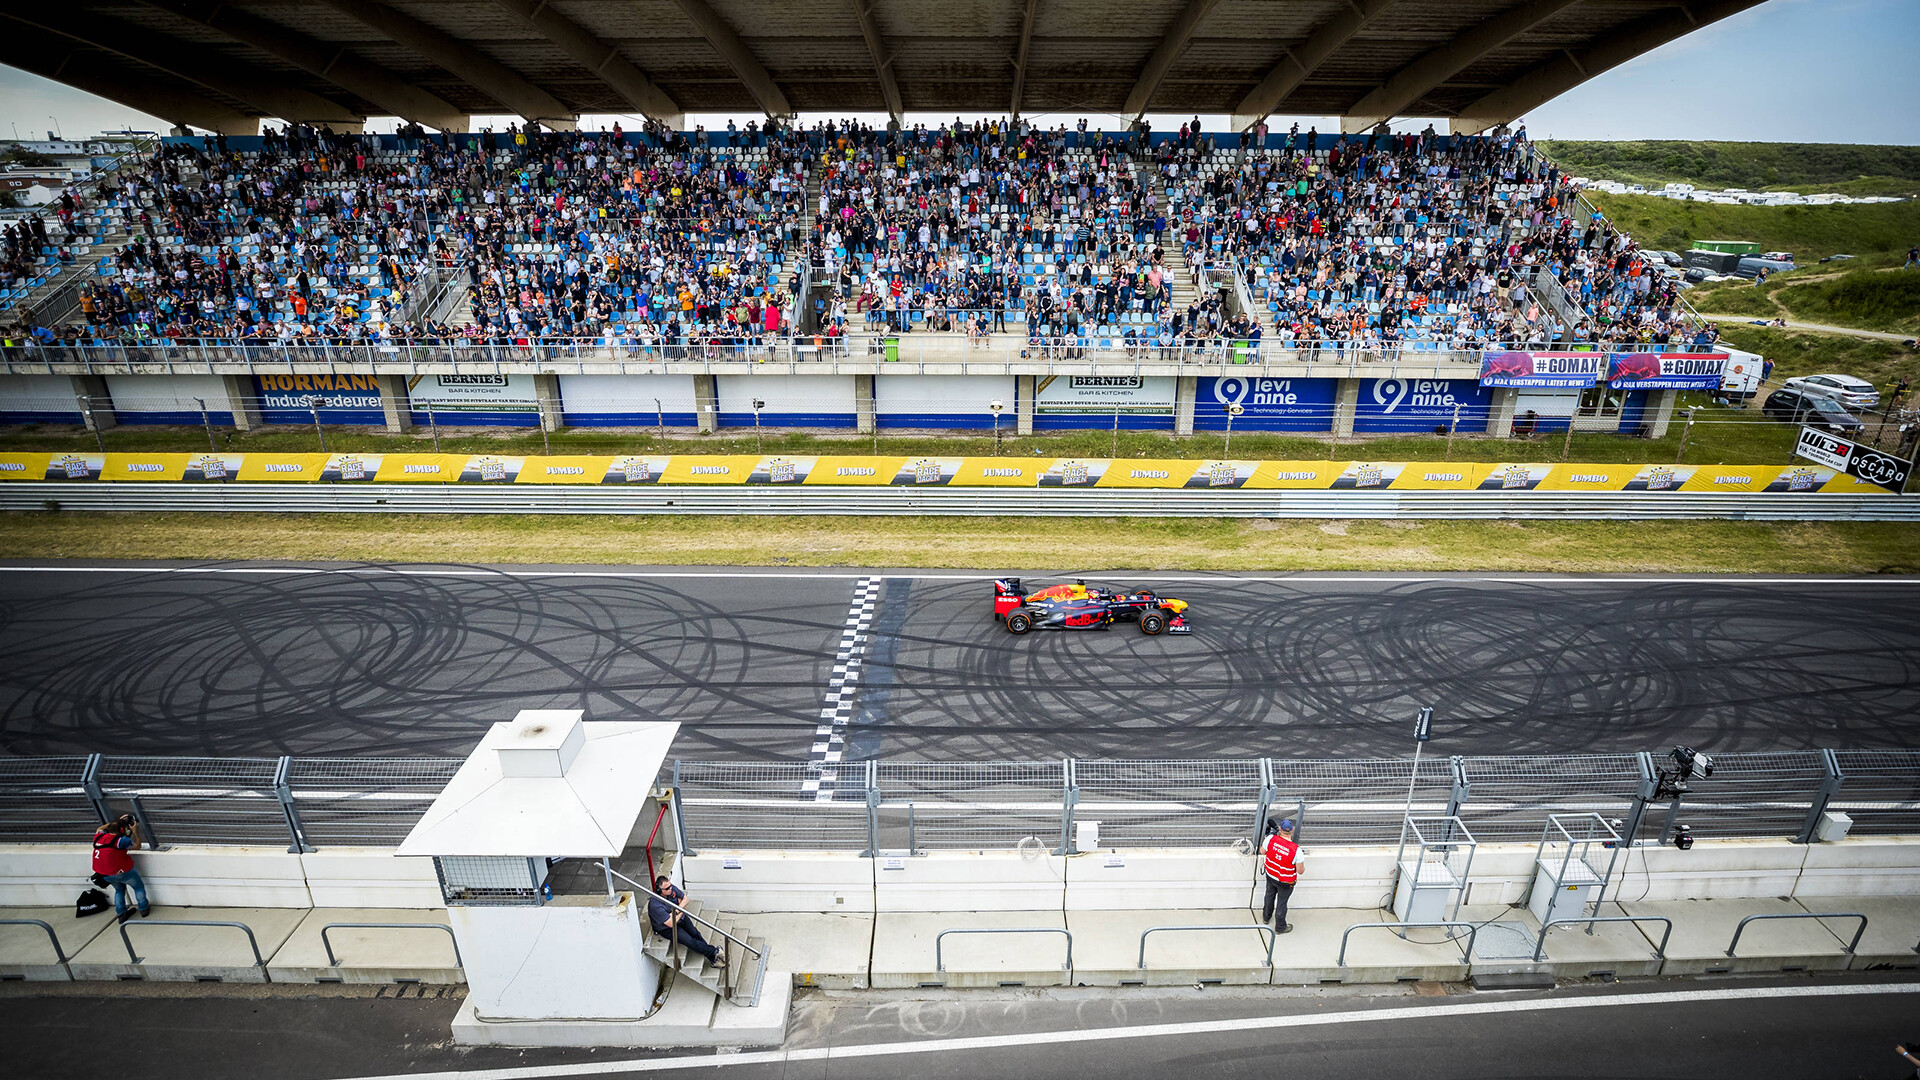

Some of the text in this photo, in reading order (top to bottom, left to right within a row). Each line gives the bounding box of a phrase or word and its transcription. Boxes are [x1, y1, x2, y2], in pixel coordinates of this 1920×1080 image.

[1536, 358, 1598, 374] #GOMAX
[1663, 359, 1725, 375] #GOMAX
[443, 374, 503, 384] BERNIE'S
[1074, 376, 1138, 386] BERNIE'S
[1494, 378, 1508, 386] MAX
[1255, 378, 1291, 392] levi
[1413, 379, 1449, 393] levi
[1636, 381, 1672, 389] VERSTAPPEN
[1253, 393, 1297, 404] nine
[1411, 394, 1455, 406] nine
[64, 461, 86, 472] RACE
[128, 463, 164, 472] JUMBO
[202, 461, 224, 472] RACE
[265, 463, 303, 472] JUMBO
[340, 462, 363, 472] RACE
[404, 464, 440, 474] JUMBO
[481, 463, 504, 473] RACE
[546, 466, 584, 475] JUMBO
[625, 464, 648, 474] RACE
[690, 466, 730, 475] JUMBO
[771, 465, 794, 475] RACE
[836, 467, 875, 476] JUMBO
[916, 466, 940, 475] RACE
[1850, 456, 1904, 482] OSCARO
[983, 468, 1022, 477] JUMBO
[1064, 467, 1087, 478] RACE
[1131, 470, 1169, 479] JUMBO
[1211, 469, 1234, 479] RACE
[1277, 472, 1316, 480] JUMBO
[1358, 469, 1382, 480] RACE
[1423, 473, 1463, 482] JUMBO
[1505, 471, 1529, 481] RACE
[1650, 472, 1673, 482] RACE
[1569, 474, 1608, 483] JUMBO
[1714, 476, 1752, 485] JUMBO
[1791, 474, 1815, 483] RACE
[94, 849, 100, 859] 2
[1274, 853, 1282, 861] 25
